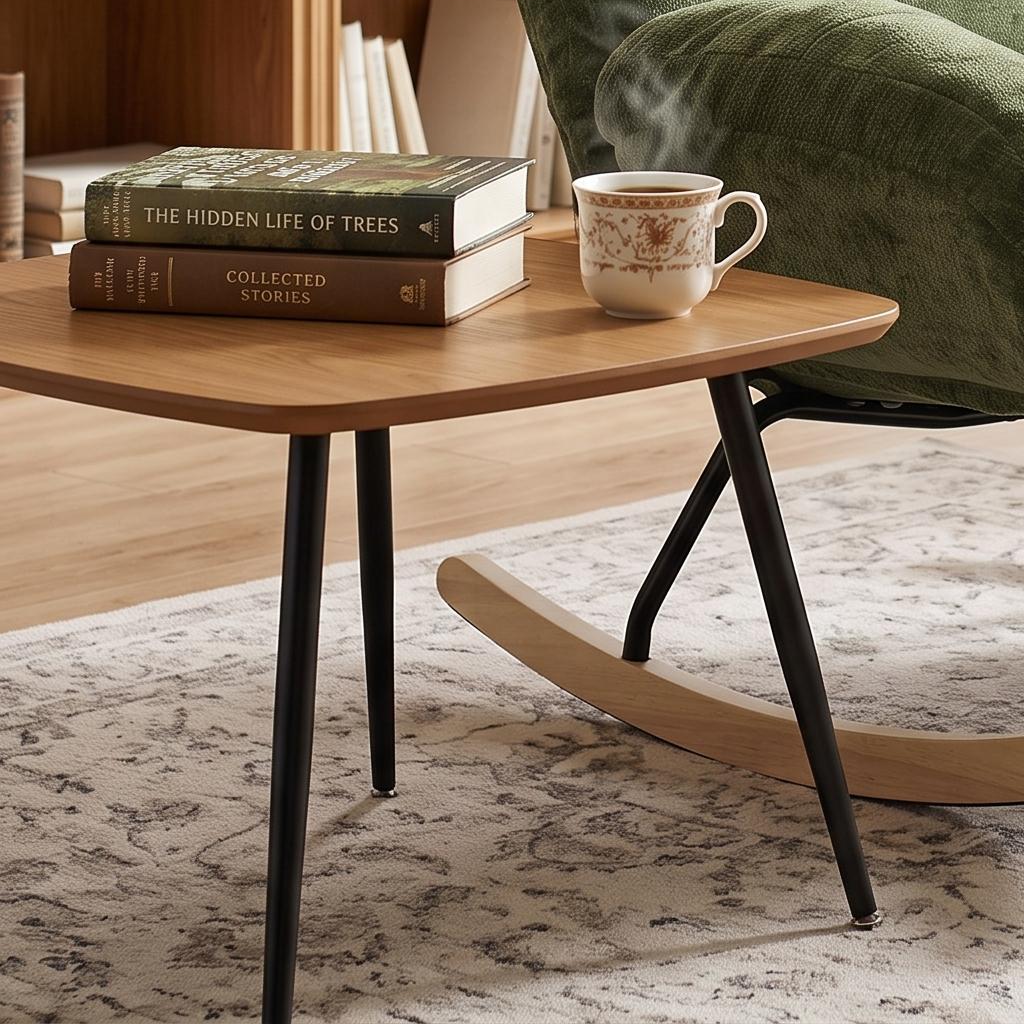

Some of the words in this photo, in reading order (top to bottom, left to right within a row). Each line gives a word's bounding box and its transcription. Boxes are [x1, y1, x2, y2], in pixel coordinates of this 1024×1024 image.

[143, 207, 180, 225] THE
[186, 208, 259, 228] HIDDEN
[265, 212, 305, 231] LIFE
[310, 214, 336, 232] OF
[340, 215, 399, 234] TREES
[226, 270, 326, 288] COLLECTED
[240, 288, 311, 306] STORIES
